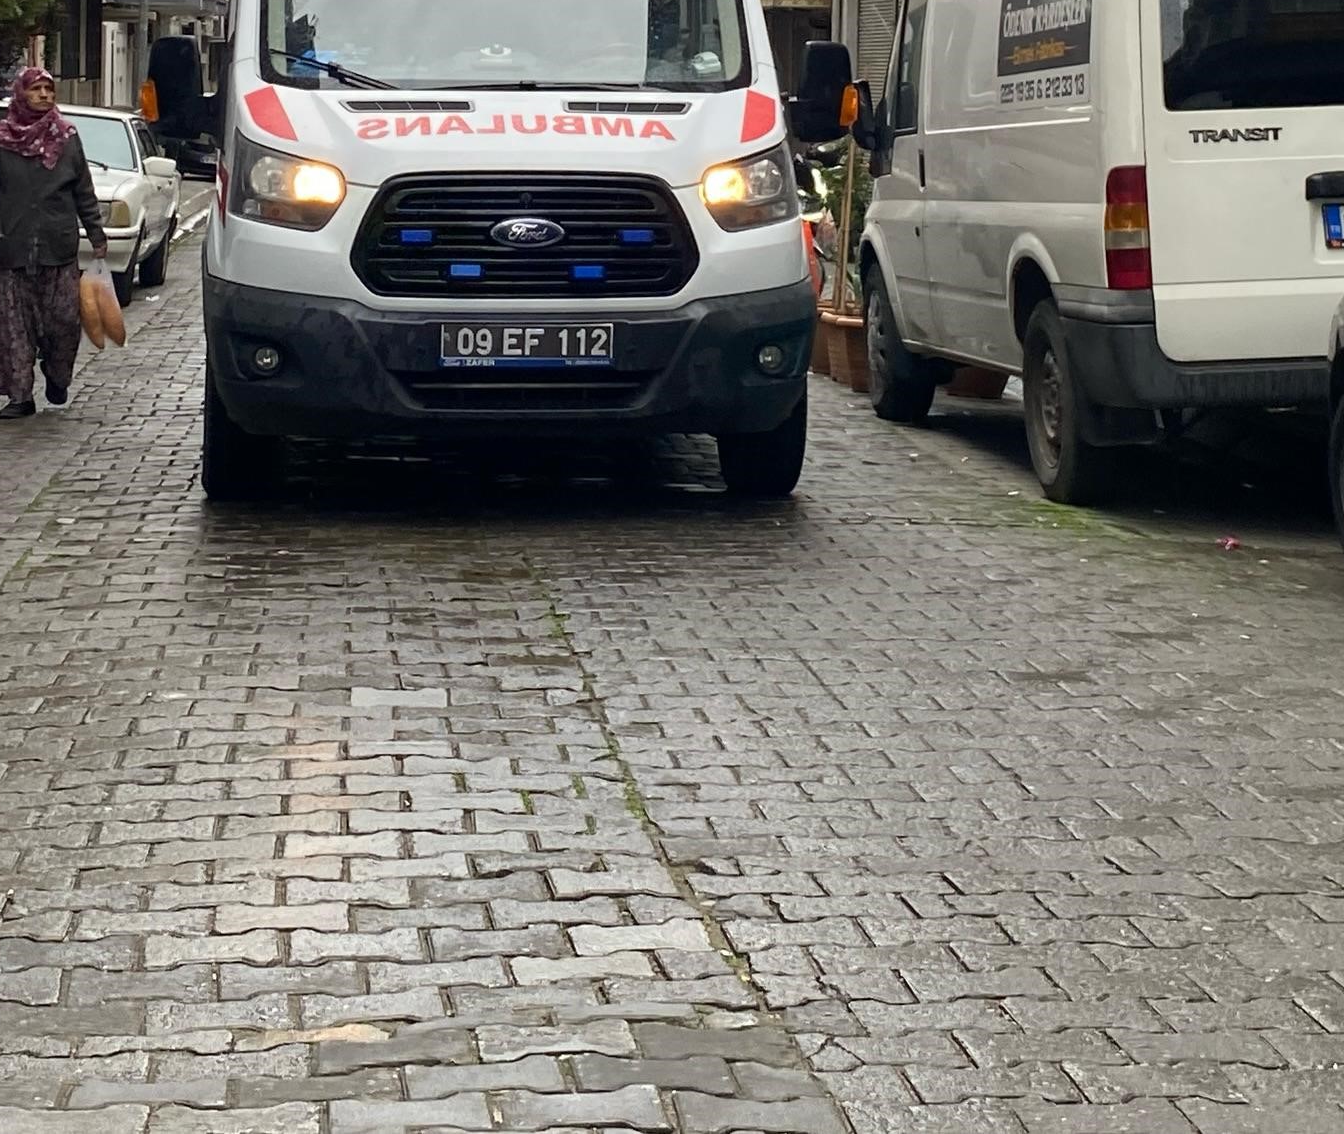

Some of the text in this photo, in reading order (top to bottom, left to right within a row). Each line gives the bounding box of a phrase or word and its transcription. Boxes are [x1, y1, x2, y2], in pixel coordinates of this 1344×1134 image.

[1189, 127, 1283, 143] TRANSIT
[508, 223, 548, 240] Ford
[457, 328, 608, 356] 09 EF 112
